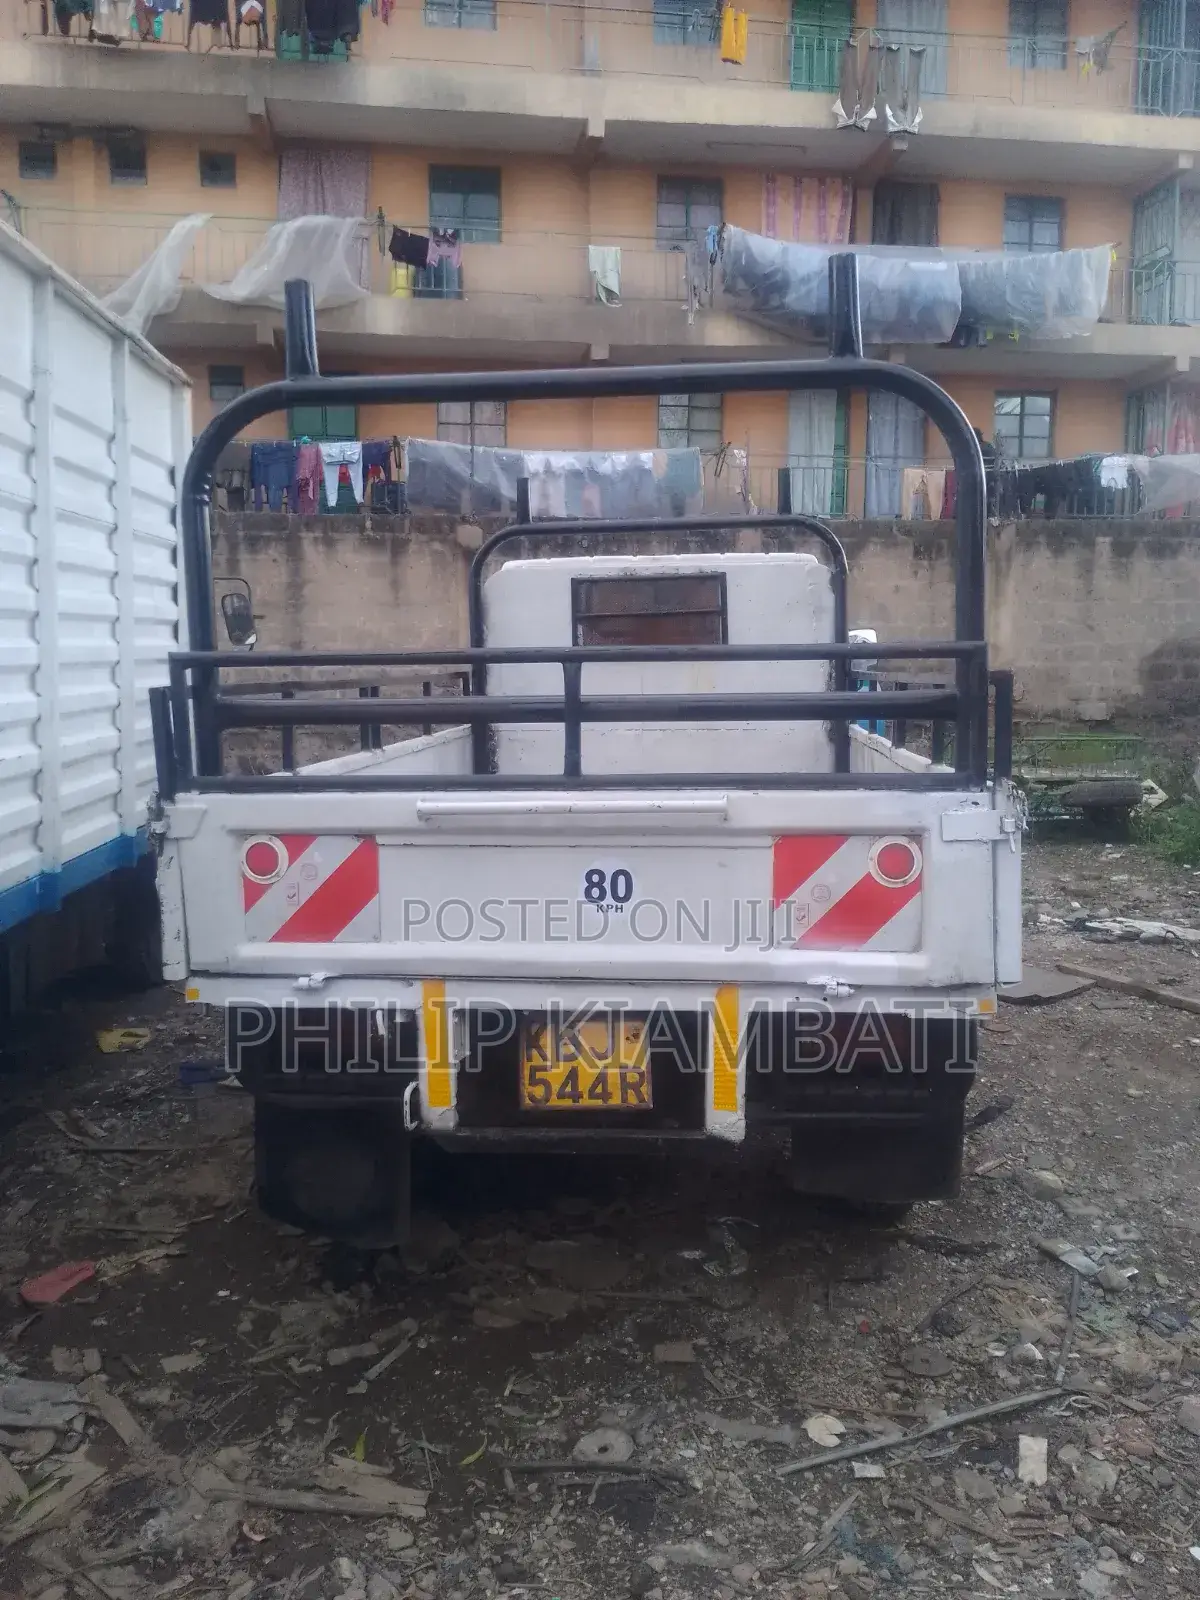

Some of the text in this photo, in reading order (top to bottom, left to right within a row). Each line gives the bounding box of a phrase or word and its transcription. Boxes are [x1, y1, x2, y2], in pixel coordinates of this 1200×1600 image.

[584, 868, 634, 904] 80
[596, 904, 624, 913] KPH
[526, 1064, 648, 1105] 544R
